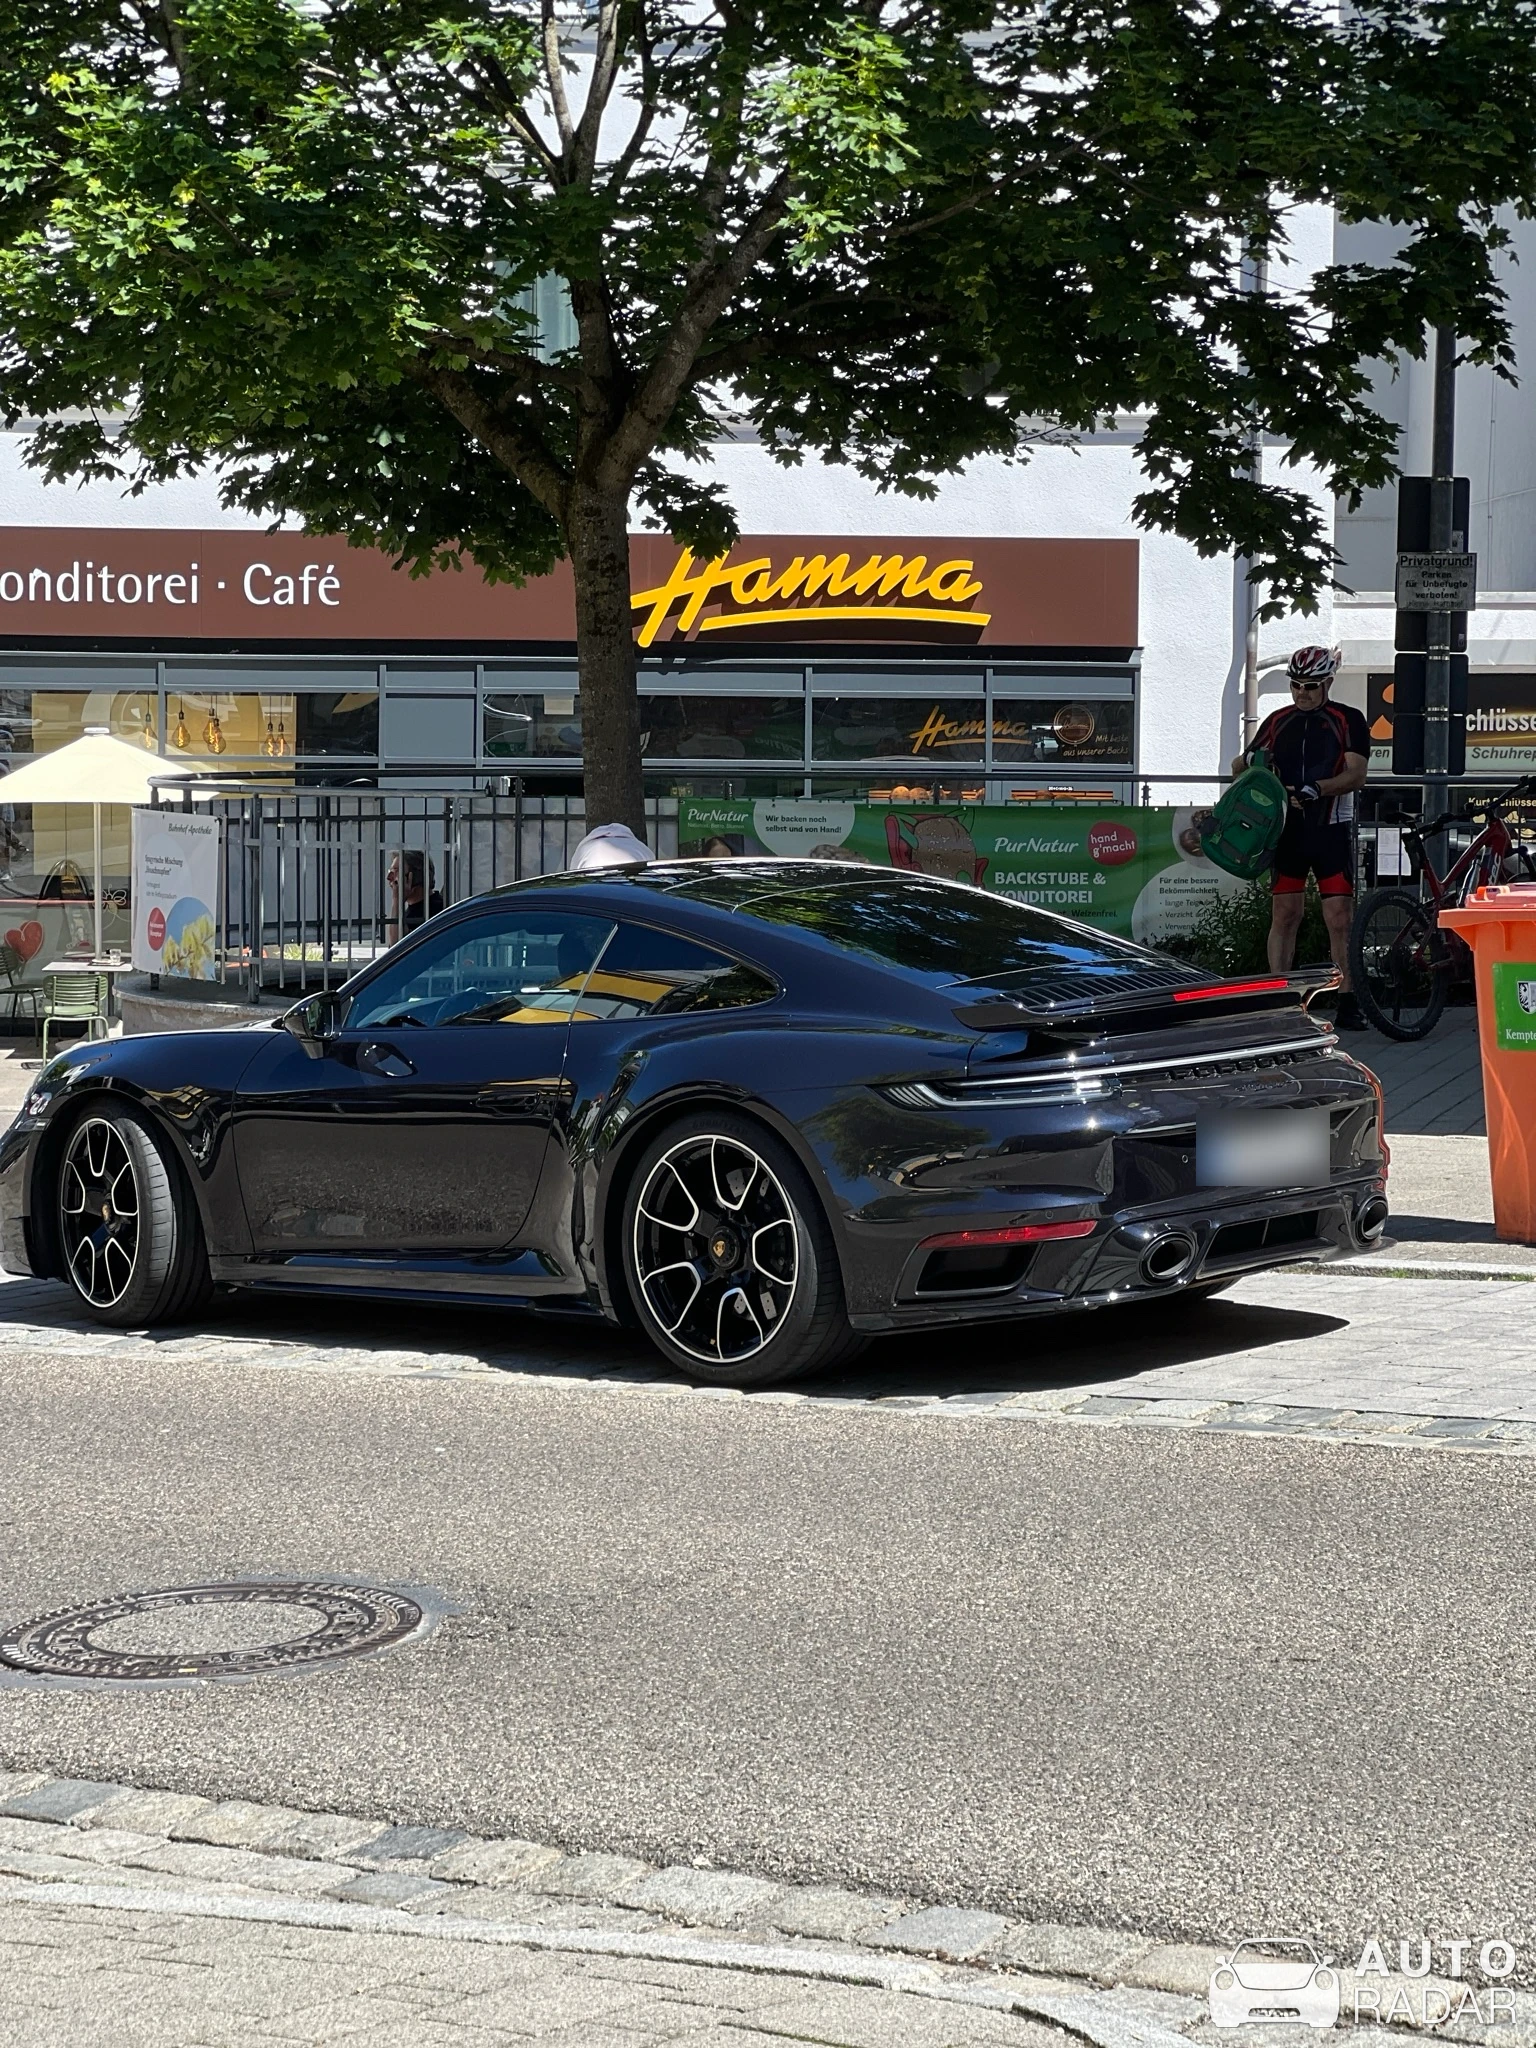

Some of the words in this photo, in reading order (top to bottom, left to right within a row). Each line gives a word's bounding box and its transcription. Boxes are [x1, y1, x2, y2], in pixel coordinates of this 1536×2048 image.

[1400, 556, 1473, 568] Privatgrund!
[0, 561, 199, 604] onditorei
[243, 563, 340, 606] Café
[1423, 580, 1468, 589] Unbefugte
[631, 546, 983, 648] Hamma
[1416, 591, 1458, 599] verboten!
[909, 705, 1030, 754] Hamma
[687, 808, 749, 822] PurNatur
[168, 823, 188, 835] Bahnhof
[188, 825, 212, 836] Apotheke
[1090, 831, 1118, 844] hand
[994, 837, 1079, 853] PurNatur
[1093, 840, 1135, 858] g'macht
[994, 872, 1089, 885] BACKSTUBE
[1093, 872, 1106, 885] &
